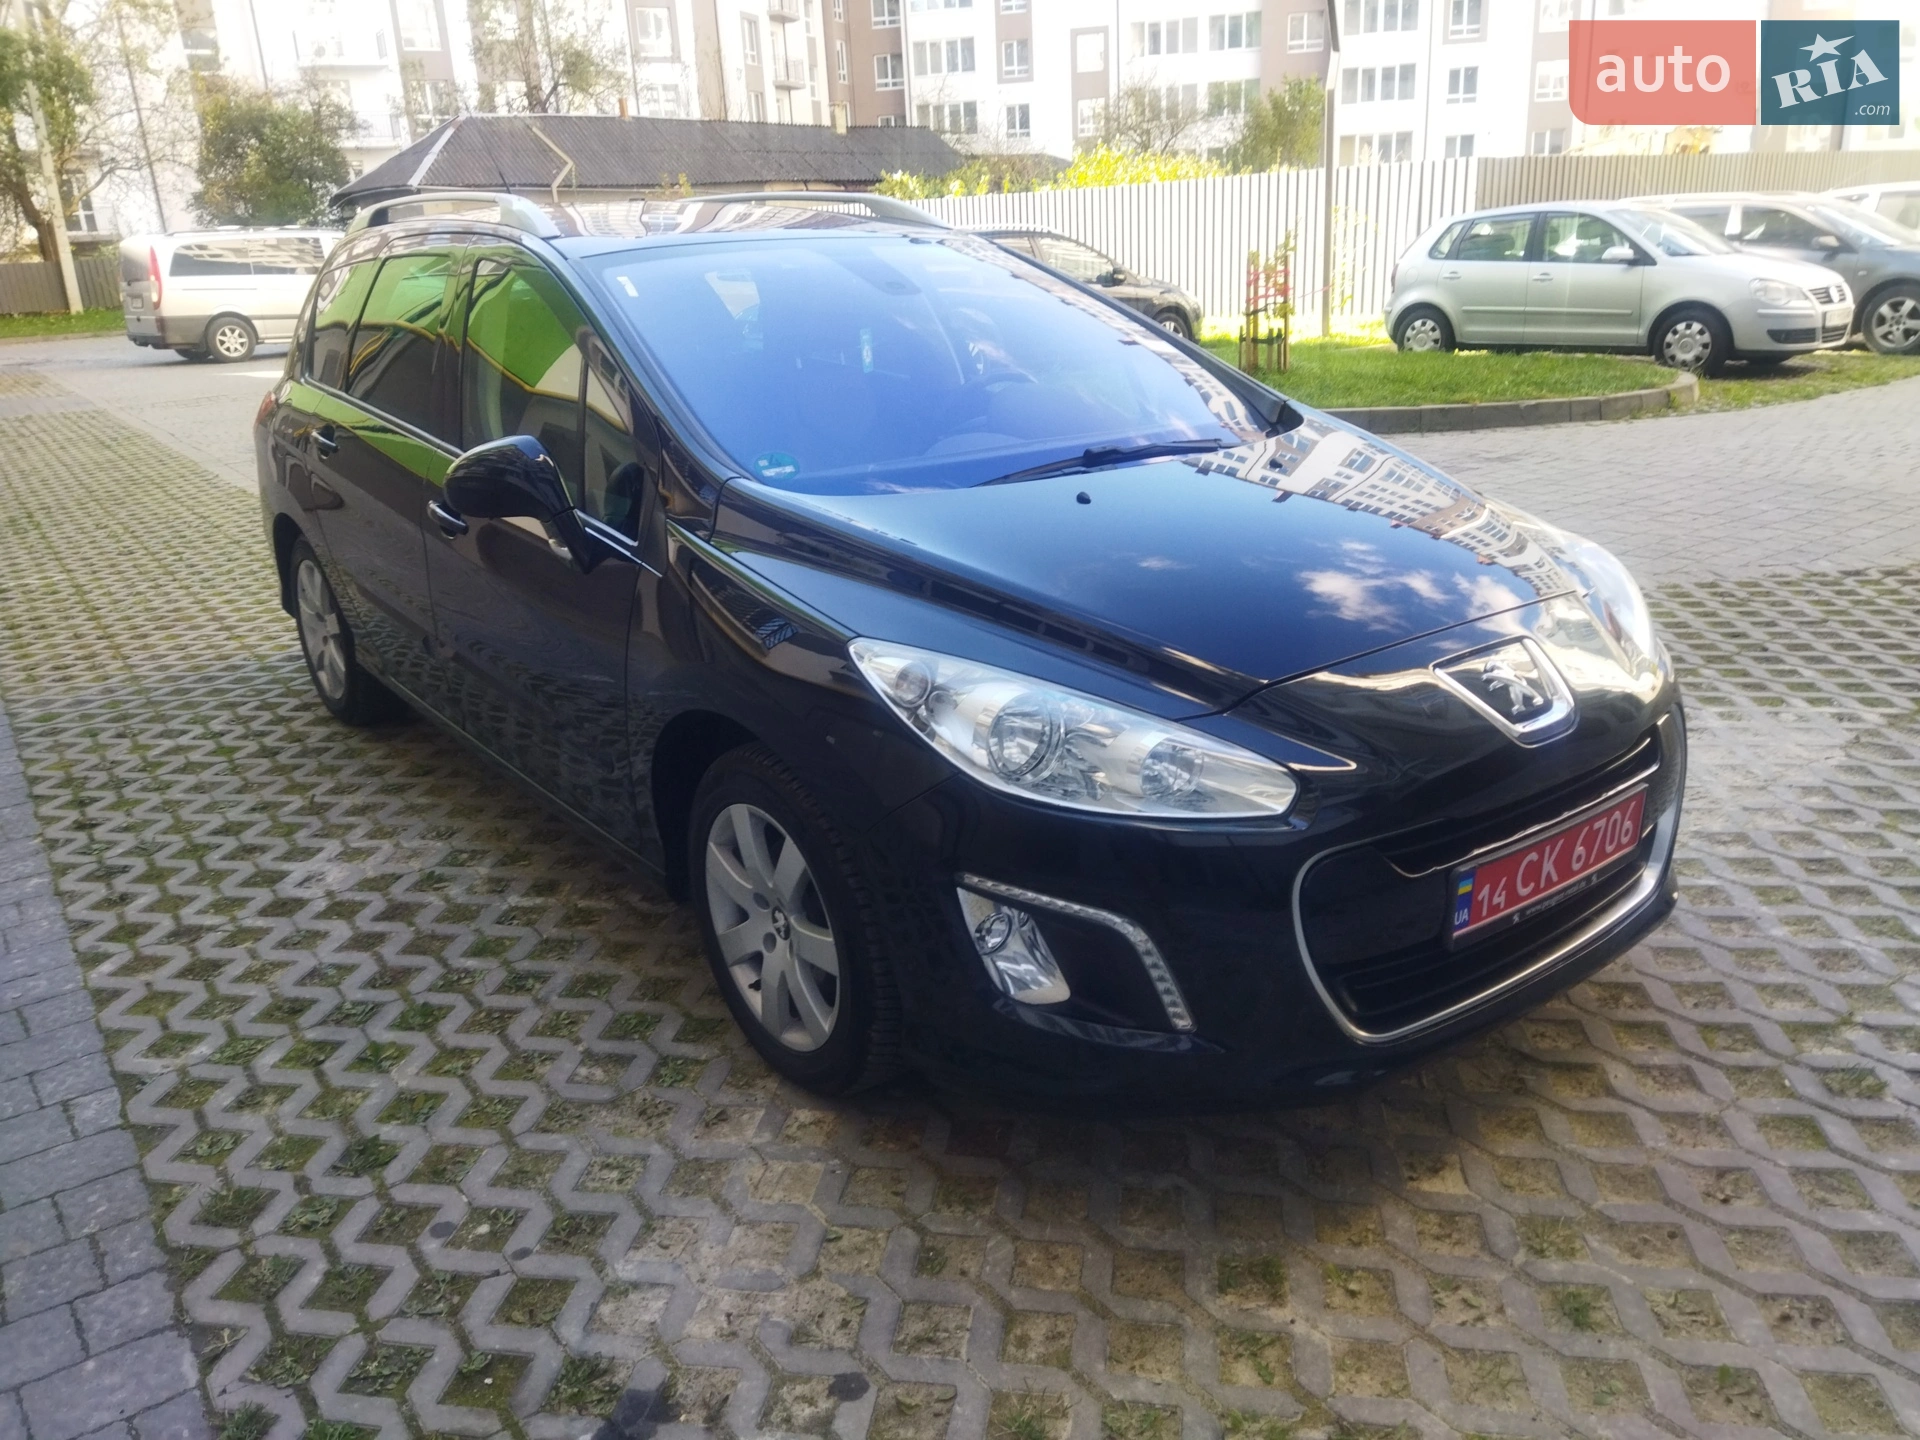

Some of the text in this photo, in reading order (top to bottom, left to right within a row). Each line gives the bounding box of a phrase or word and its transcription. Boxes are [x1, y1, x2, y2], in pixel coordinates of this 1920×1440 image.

[1477, 876, 1507, 917] 14
[1516, 838, 1565, 897] CK
[1571, 801, 1636, 872] 6706
[1454, 908, 1469, 925] UA
